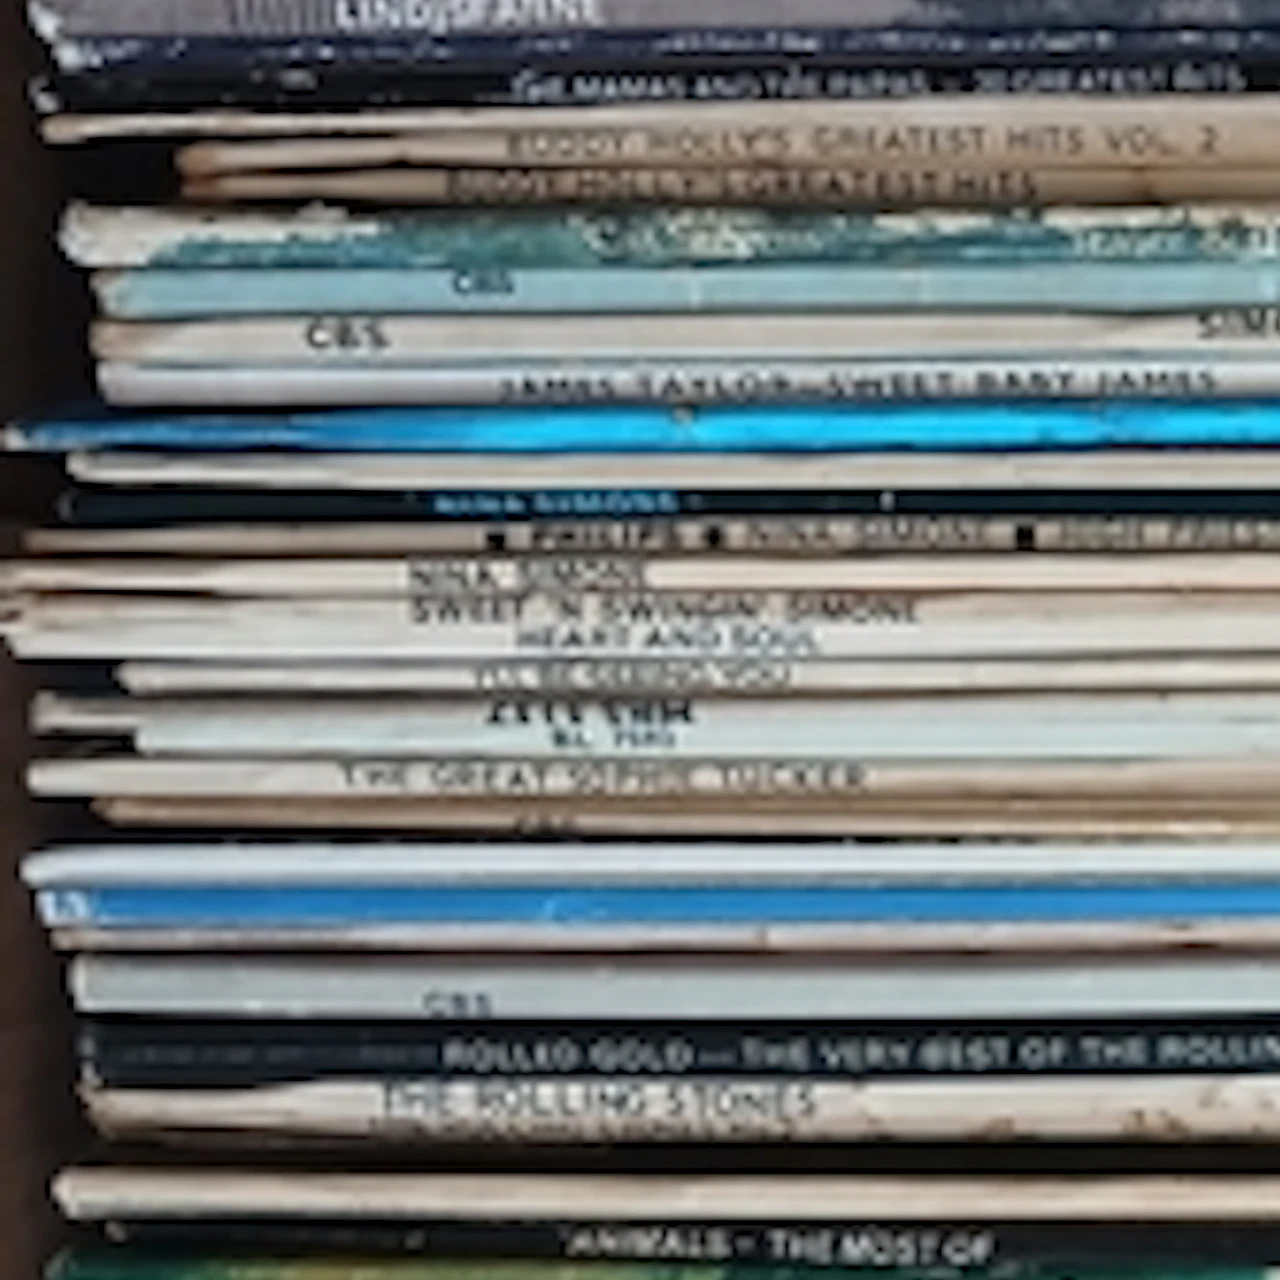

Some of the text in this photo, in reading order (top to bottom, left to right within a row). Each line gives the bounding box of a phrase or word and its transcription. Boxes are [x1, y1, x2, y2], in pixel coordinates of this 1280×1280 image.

[814, 125, 986, 156] GREATEST
[1006, 126, 1083, 154] HITS
[1196, 125, 1220, 152] 2
[409, 597, 523, 625] SWEET
[442, 1040, 575, 1072] ROLLED
[598, 1039, 693, 1071] GOLD
[741, 1039, 808, 1069] THE
[825, 1038, 916, 1068] VERY
[928, 1037, 1009, 1067] BEST
[1020, 1036, 1072, 1066] OF
[1084, 1036, 1148, 1065] THE
[475, 1083, 645, 1118] ROLLING
